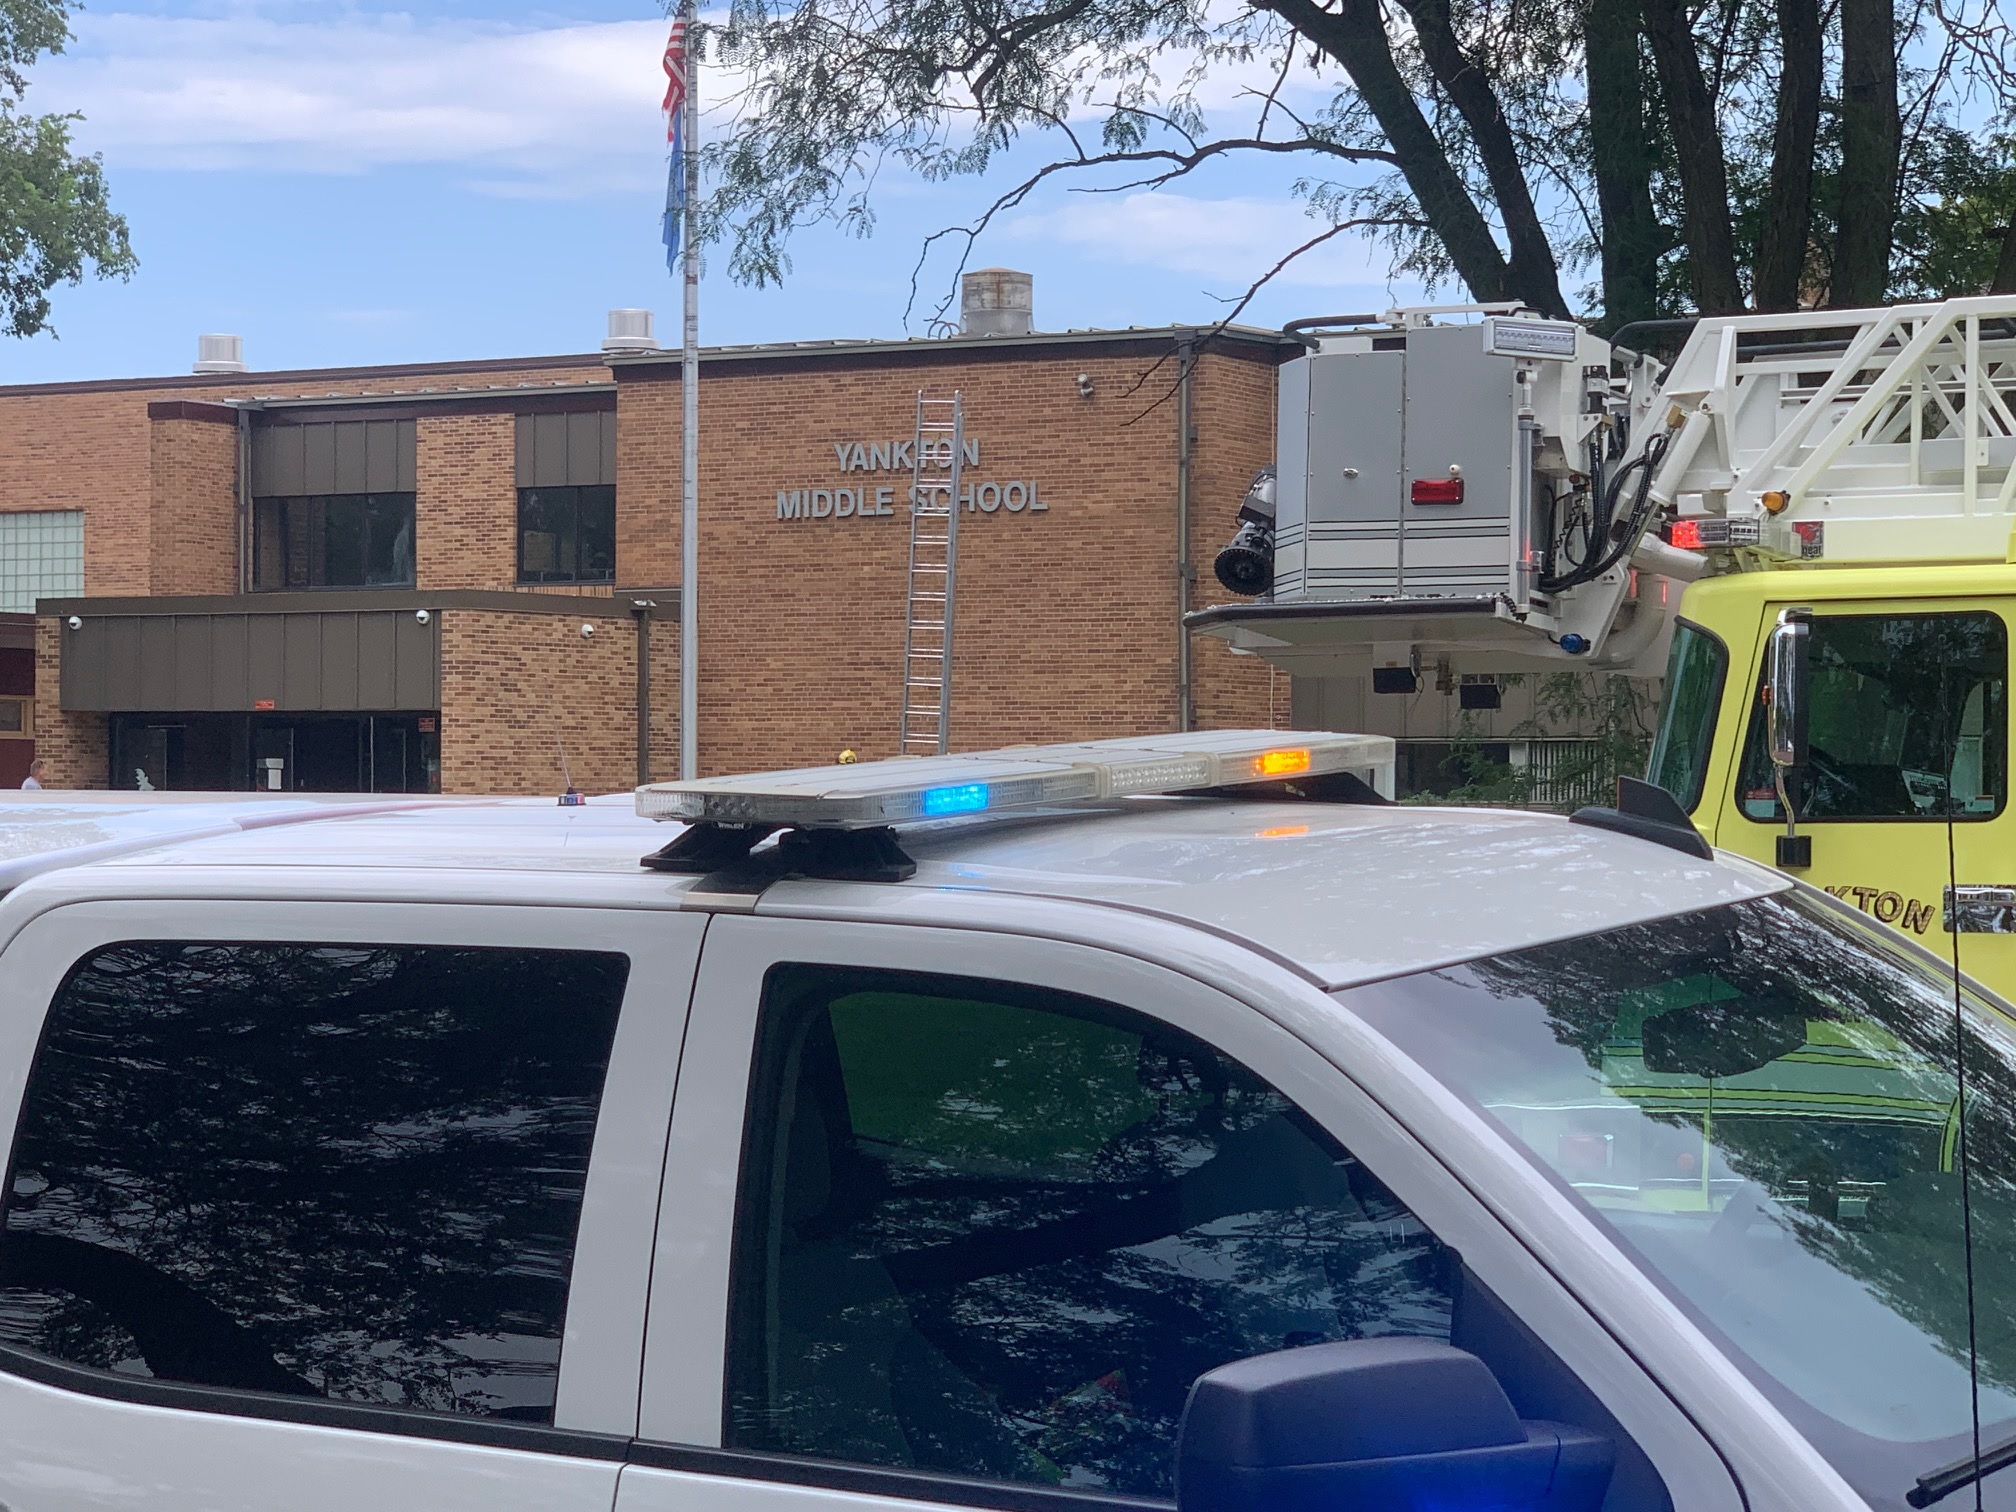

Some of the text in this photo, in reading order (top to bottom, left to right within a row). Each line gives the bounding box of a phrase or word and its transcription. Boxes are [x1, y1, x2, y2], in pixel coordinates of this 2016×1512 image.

[834, 438, 979, 471] YANKTON
[776, 481, 1049, 519] MIDDLE SCHOOL
